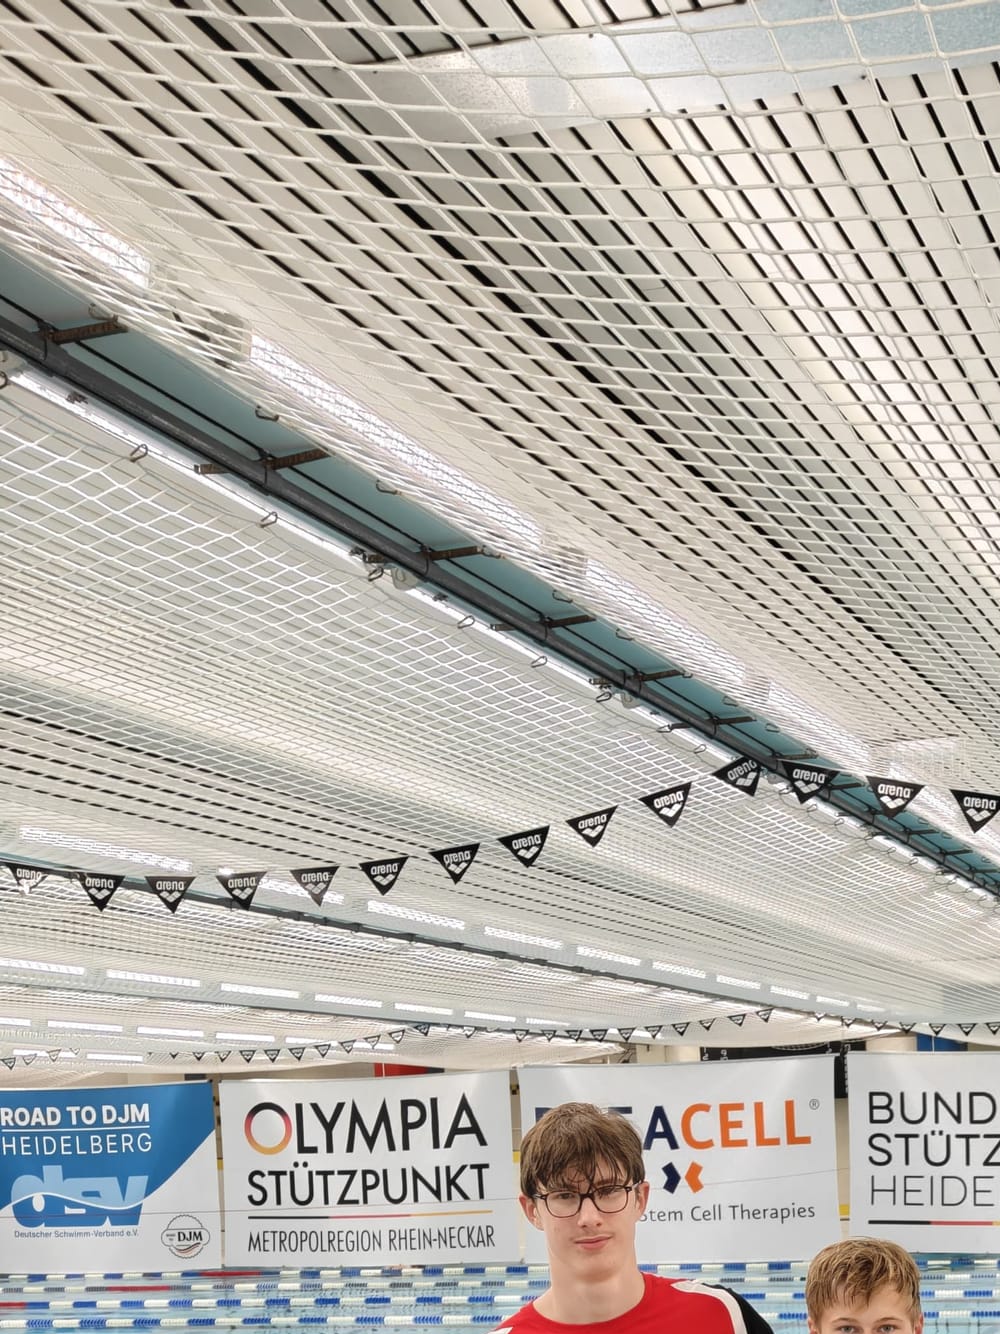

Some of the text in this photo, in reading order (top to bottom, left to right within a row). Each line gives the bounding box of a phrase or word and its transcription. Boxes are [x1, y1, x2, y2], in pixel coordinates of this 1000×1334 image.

[727, 760, 758, 781] arena
[793, 769, 826, 783] arena
[878, 783, 913, 798] arena
[653, 790, 684, 808] arena
[964, 796, 996, 810] arena
[578, 813, 607, 830] arena
[512, 833, 541, 850] arena
[443, 850, 471, 864] arena
[370, 863, 398, 876] arena
[85, 877, 114, 890] arena
[156, 880, 186, 892] arena
[227, 877, 256, 890] arena
[301, 872, 329, 884] arena
[1, 1104, 149, 1127] ROAD TO DJM
[244, 1092, 488, 1156] OLYMPIA
[2, 1133, 152, 1156] HEIDELBERG
[248, 1161, 490, 1207] STÜTZPUNKT
[11, 1165, 148, 1229] dsv
[690, 1204, 722, 1222] Cell
[728, 1202, 815, 1225] Therapies
[14, 1230, 53, 1239] Deutscher
[55, 1229, 124, 1239] Schwimm-Verband
[178, 1231, 202, 1242] DJM
[248, 1225, 495, 1253] METROPOLREGION RHEIN-NECKAR
